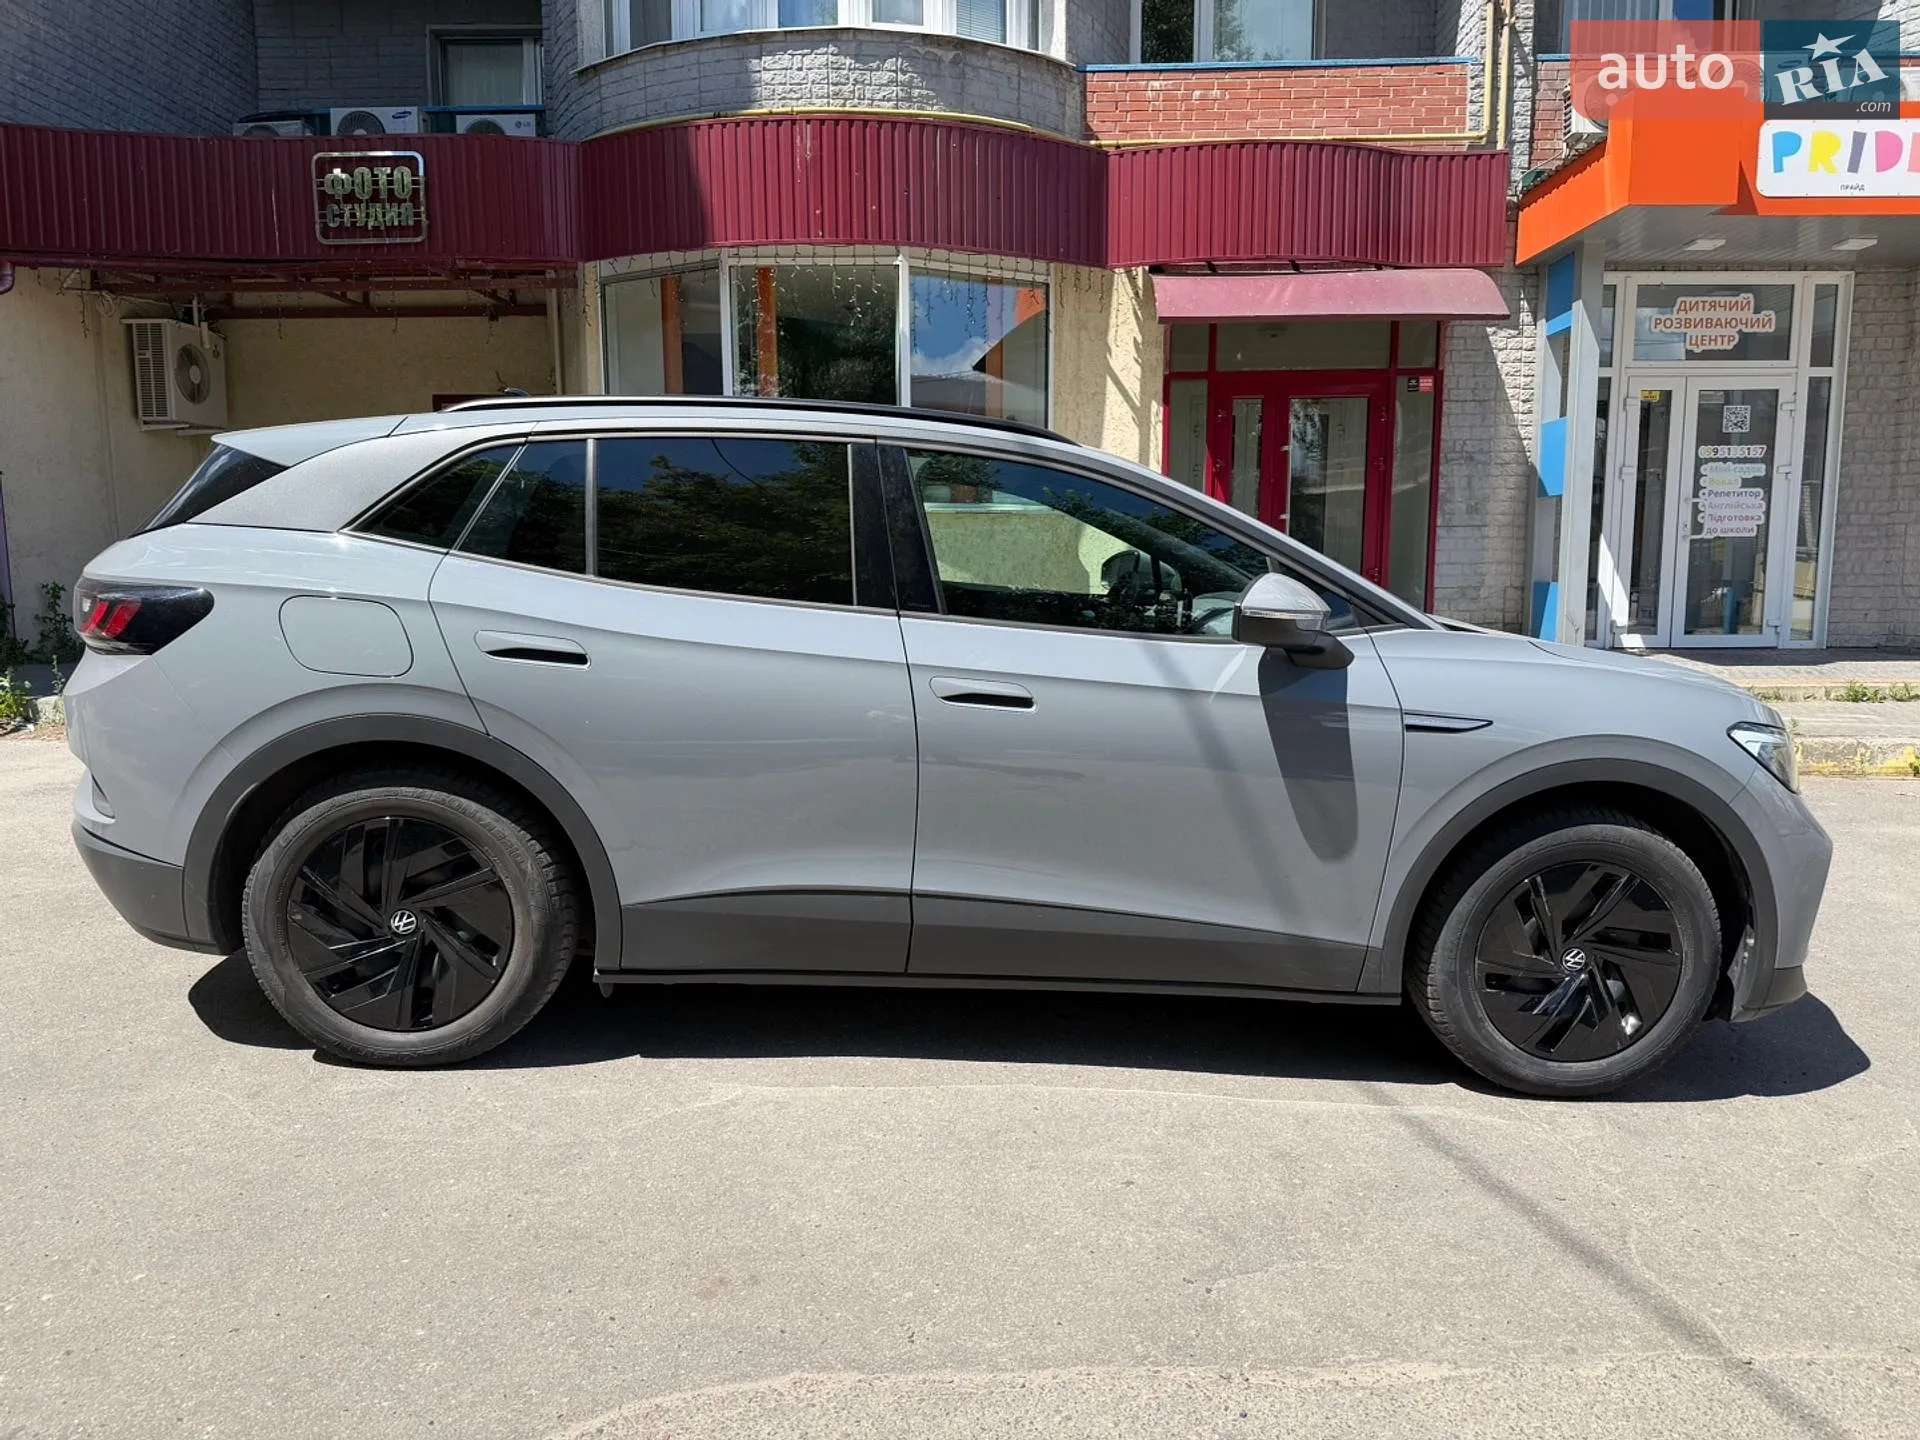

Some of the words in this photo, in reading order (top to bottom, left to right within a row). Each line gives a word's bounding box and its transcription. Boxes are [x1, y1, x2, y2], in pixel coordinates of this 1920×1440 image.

[324, 166, 412, 199] ФОТО
[327, 203, 414, 230] СТУДИЯ
[1677, 297, 1752, 314] ДИТЯЧИЙ
[1654, 314, 1773, 329] РОЗВИВАЮЧИЙ
[1688, 335, 1737, 348] ЦЕНТР
[1707, 490, 1761, 499] Репетитор
